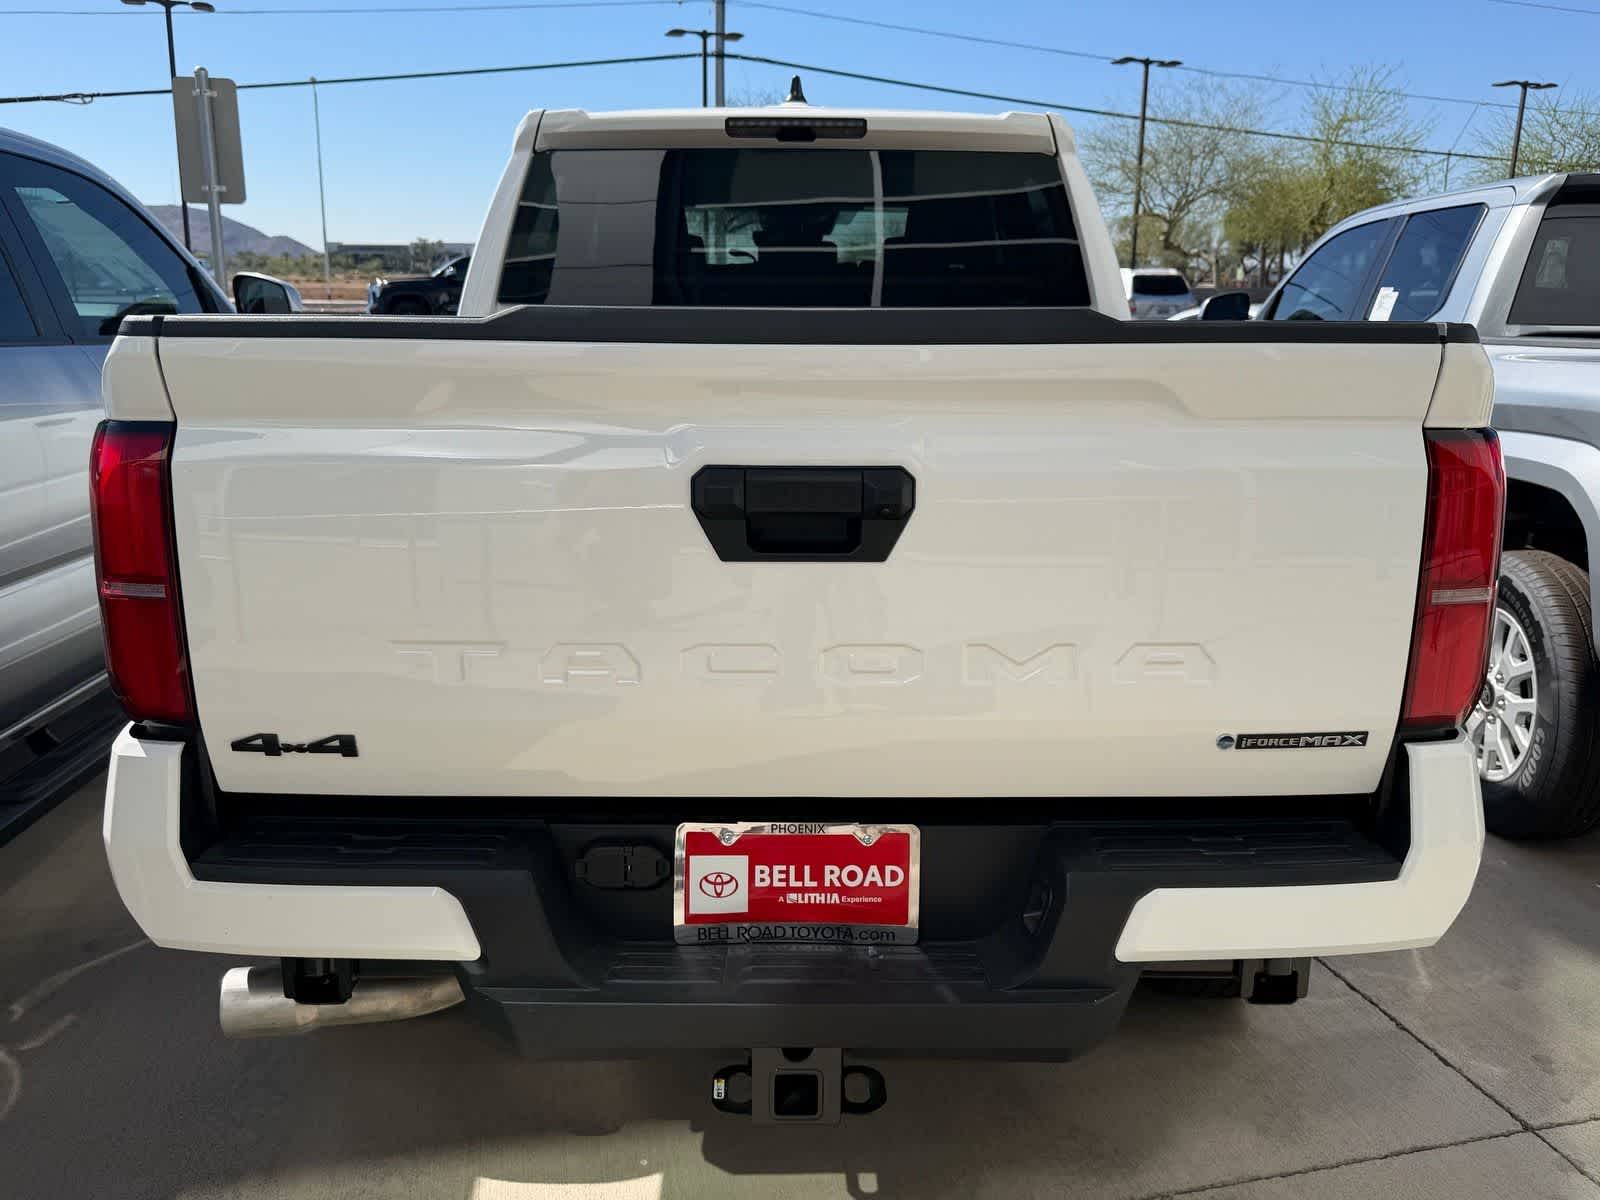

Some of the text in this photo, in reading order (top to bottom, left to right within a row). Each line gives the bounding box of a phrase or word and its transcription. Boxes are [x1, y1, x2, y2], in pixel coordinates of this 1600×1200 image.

[387, 640, 1218, 687] TACOMA
[770, 823, 826, 834] PHOENIX
[754, 864, 905, 888] BELL ROAD
[778, 892, 882, 904] A LITHIA Experience
[697, 925, 896, 942] BELL ROAD TOYOTA.com
